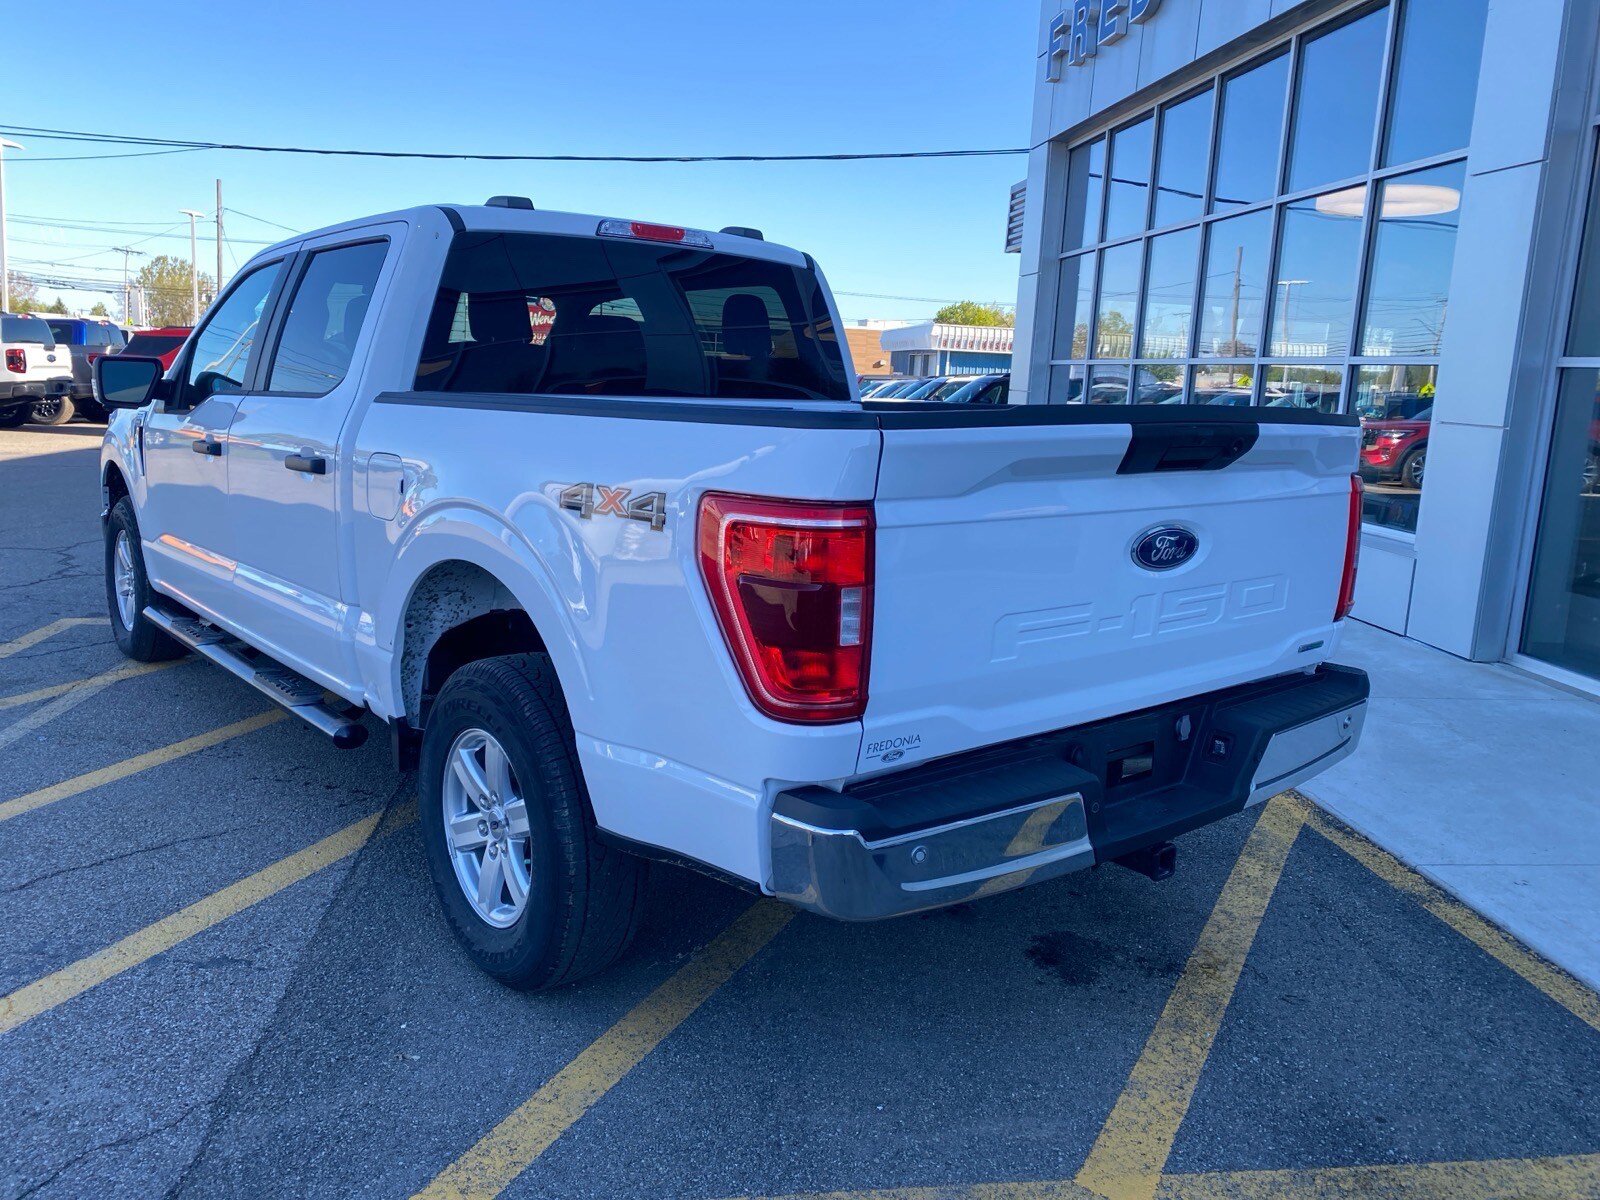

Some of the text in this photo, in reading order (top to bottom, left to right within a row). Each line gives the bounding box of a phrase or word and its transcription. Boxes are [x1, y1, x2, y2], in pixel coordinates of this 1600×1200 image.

[1151, 535, 1188, 562] Ford
[990, 573, 1290, 663] F-150
[866, 734, 922, 754] FREDONIA
